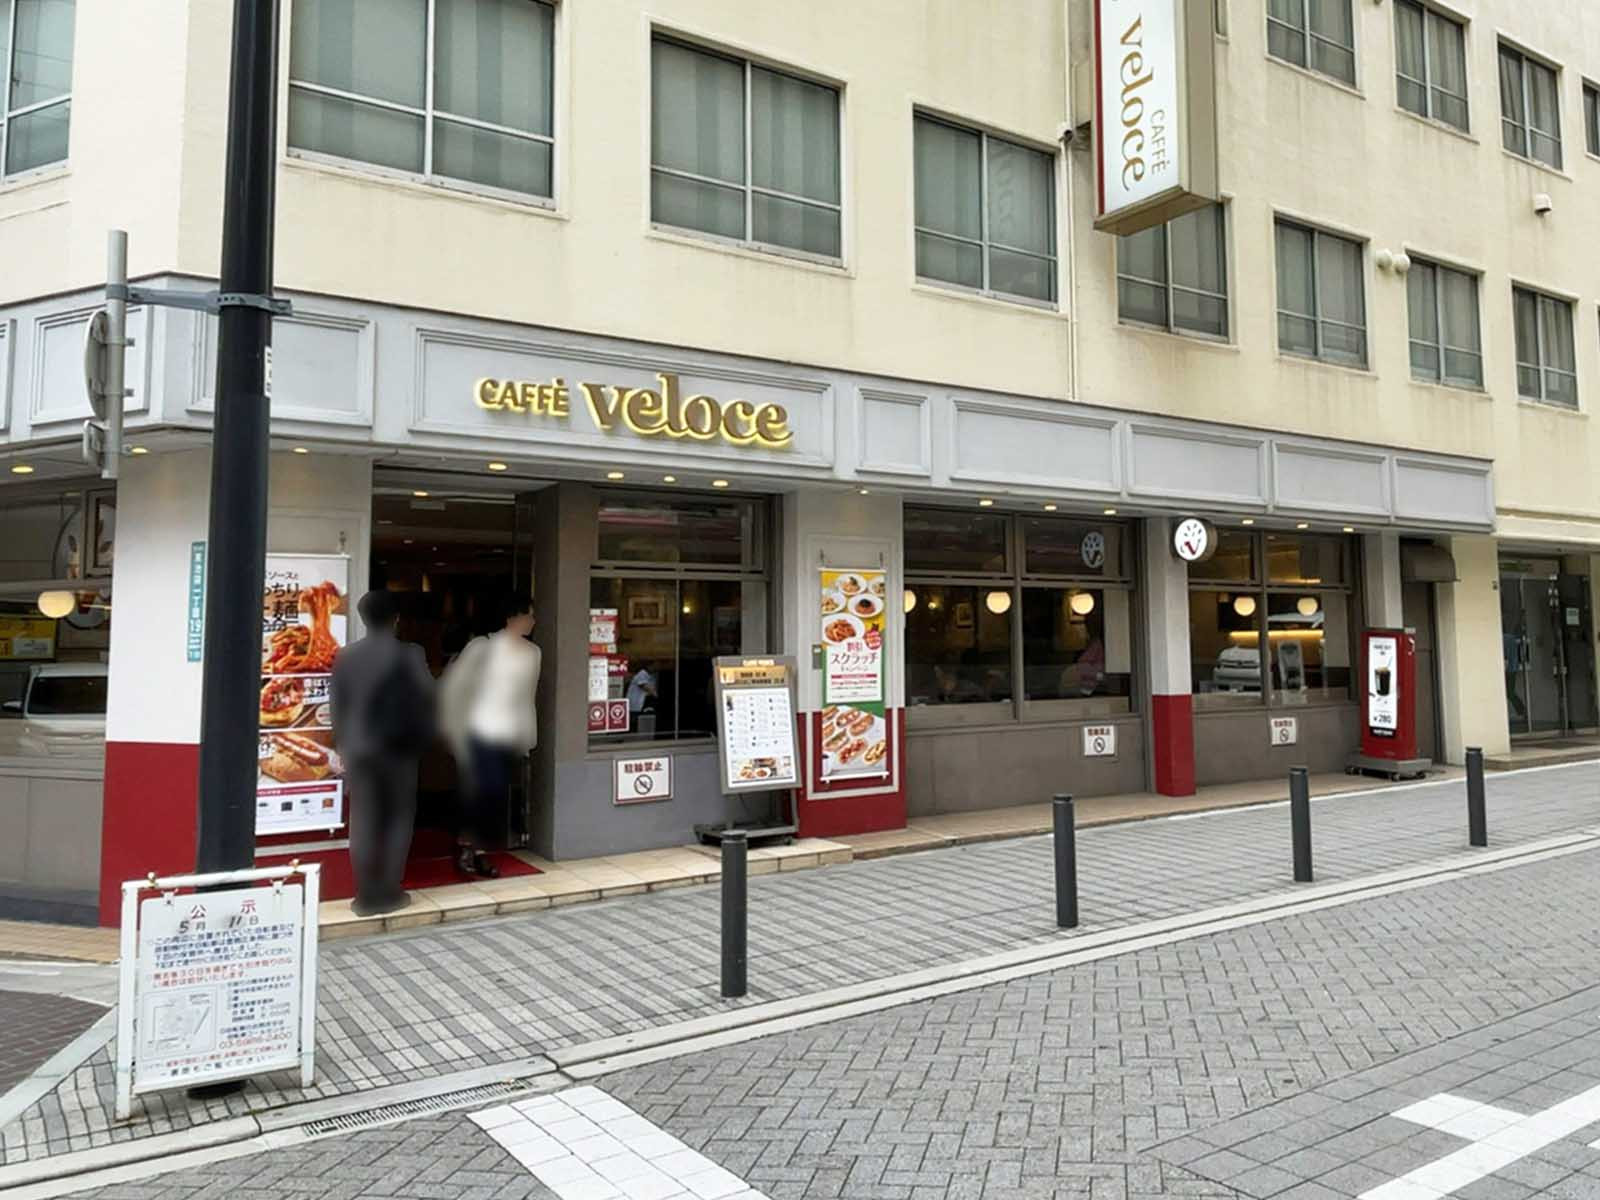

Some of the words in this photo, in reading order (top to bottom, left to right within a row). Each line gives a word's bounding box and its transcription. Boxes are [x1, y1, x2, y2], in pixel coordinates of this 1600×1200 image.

[1120, 12, 1153, 191] veloce
[578, 371, 794, 447] veloce
[264, 599, 299, 624] 麺
[831, 652, 880, 665] スクラッチ
[624, 760, 664, 775] 駐輪禁止
[191, 903, 207, 920] 公
[240, 899, 257, 914] 示
[179, 920, 190, 934] 5
